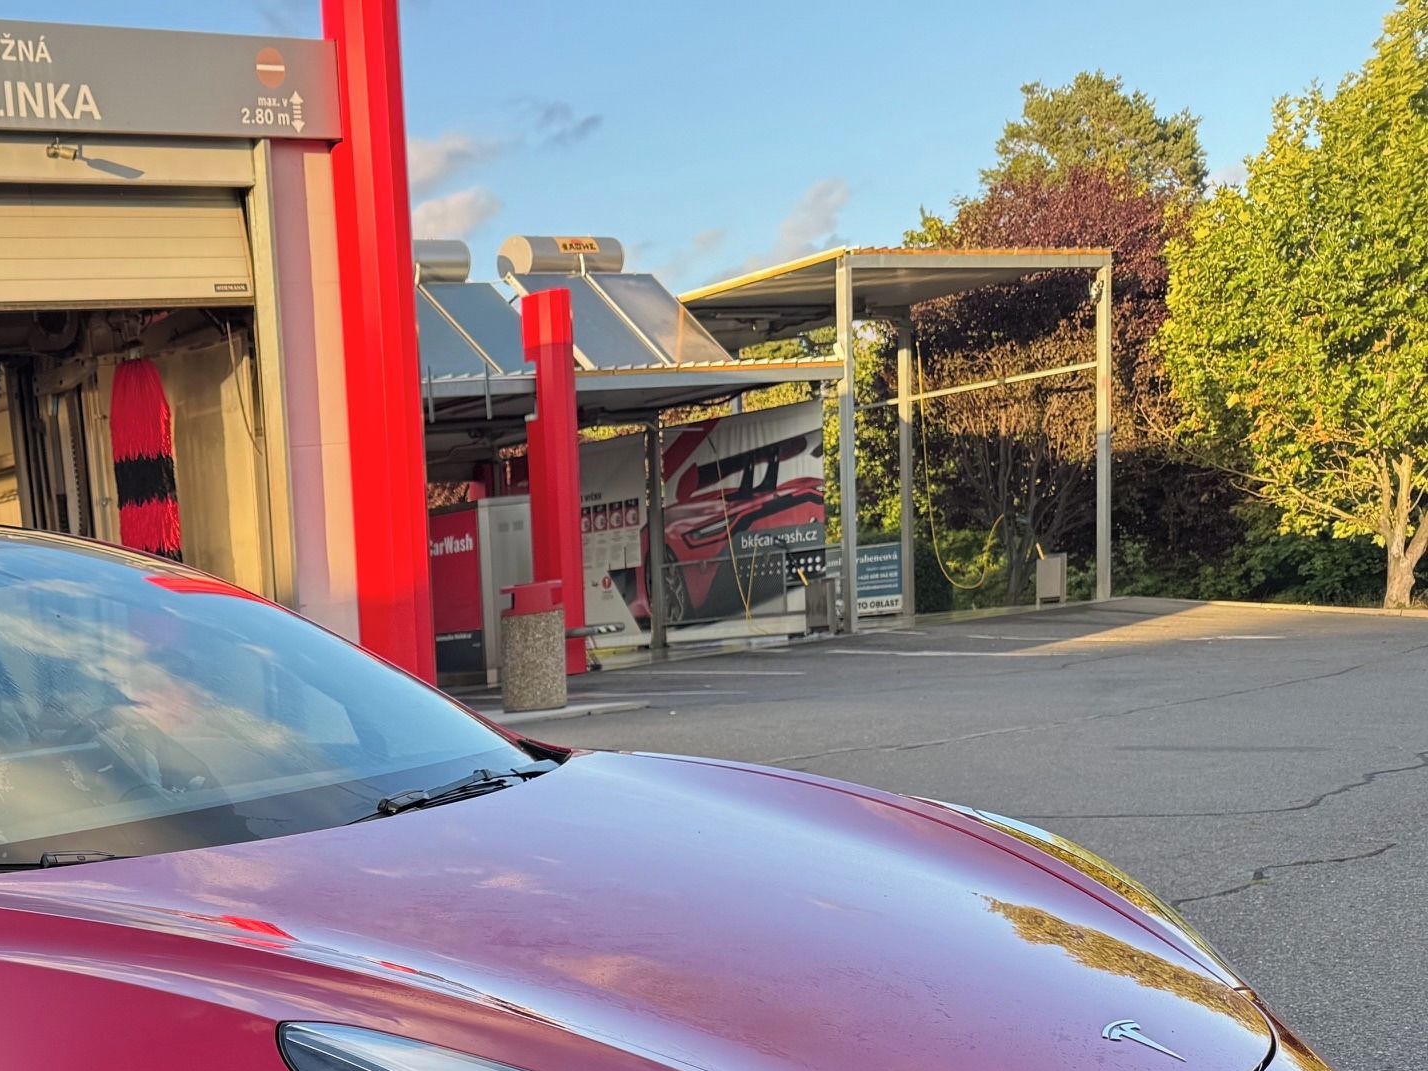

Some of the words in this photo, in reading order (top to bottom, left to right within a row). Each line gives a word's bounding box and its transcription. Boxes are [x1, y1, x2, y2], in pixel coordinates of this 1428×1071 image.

[257, 96, 280, 108] max.
[281, 98, 288, 107] v
[241, 107, 274, 125] 2.80
[277, 112, 291, 126] m
